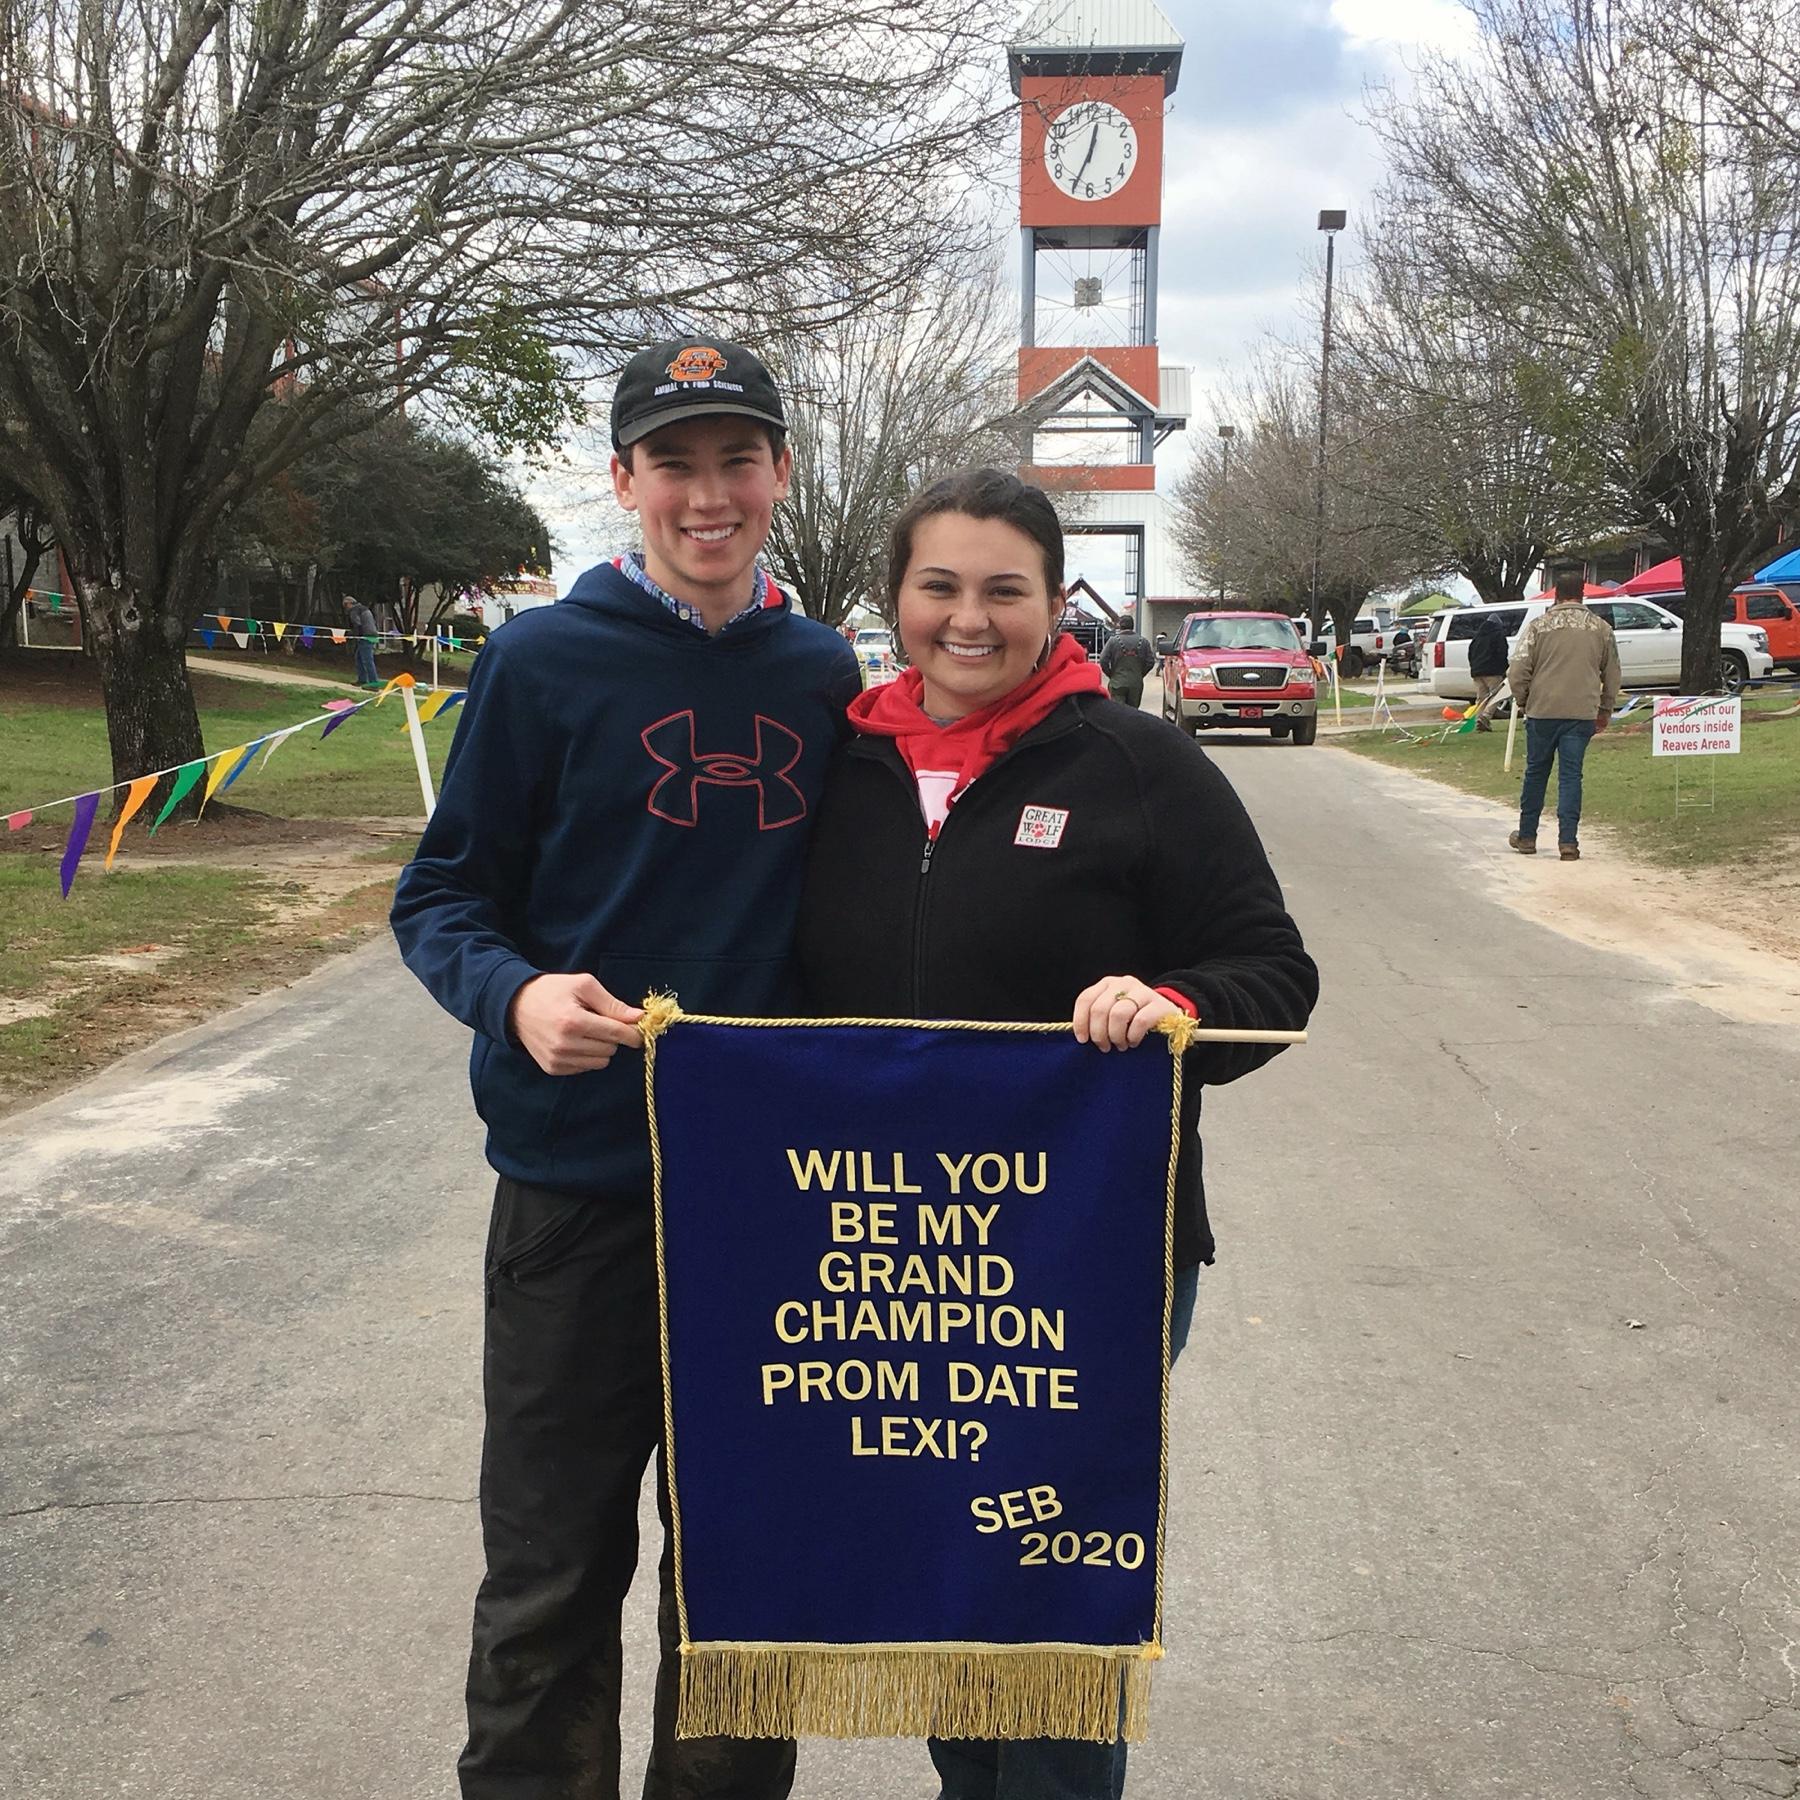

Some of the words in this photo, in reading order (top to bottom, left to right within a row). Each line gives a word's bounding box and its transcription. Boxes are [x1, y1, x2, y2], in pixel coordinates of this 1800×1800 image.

[1119, 122, 1128, 138] 2
[1050, 143, 1059, 159] 9
[1123, 143, 1132, 159] 3
[1054, 163, 1063, 179] 8
[1117, 163, 1126, 178] 4
[1085, 182, 1094, 198] 6
[1104, 178, 1112, 194] 5
[654, 382, 679, 396] ANIMAL
[1718, 705, 1736, 715] our
[1659, 722, 1701, 735] Vendors
[1704, 720, 1734, 732] inside
[1662, 739, 1698, 752] Reaves
[1701, 738, 1731, 750] Arena
[1025, 808, 1066, 824] GREAT
[786, 1148, 922, 1194] WILL
[936, 1151, 1047, 1195] YOU
[831, 1201, 899, 1245] BE
[918, 1204, 1000, 1246] MY
[819, 1251, 1014, 1297] GRAND
[774, 1299, 1065, 1352] CHAMPION
[761, 1359, 919, 1405] PROM
[948, 1362, 1079, 1410] DATE
[851, 1416, 988, 1462] LEXI?
[970, 1485, 1063, 1534] SEB
[1019, 1531, 1145, 1570] 2020
